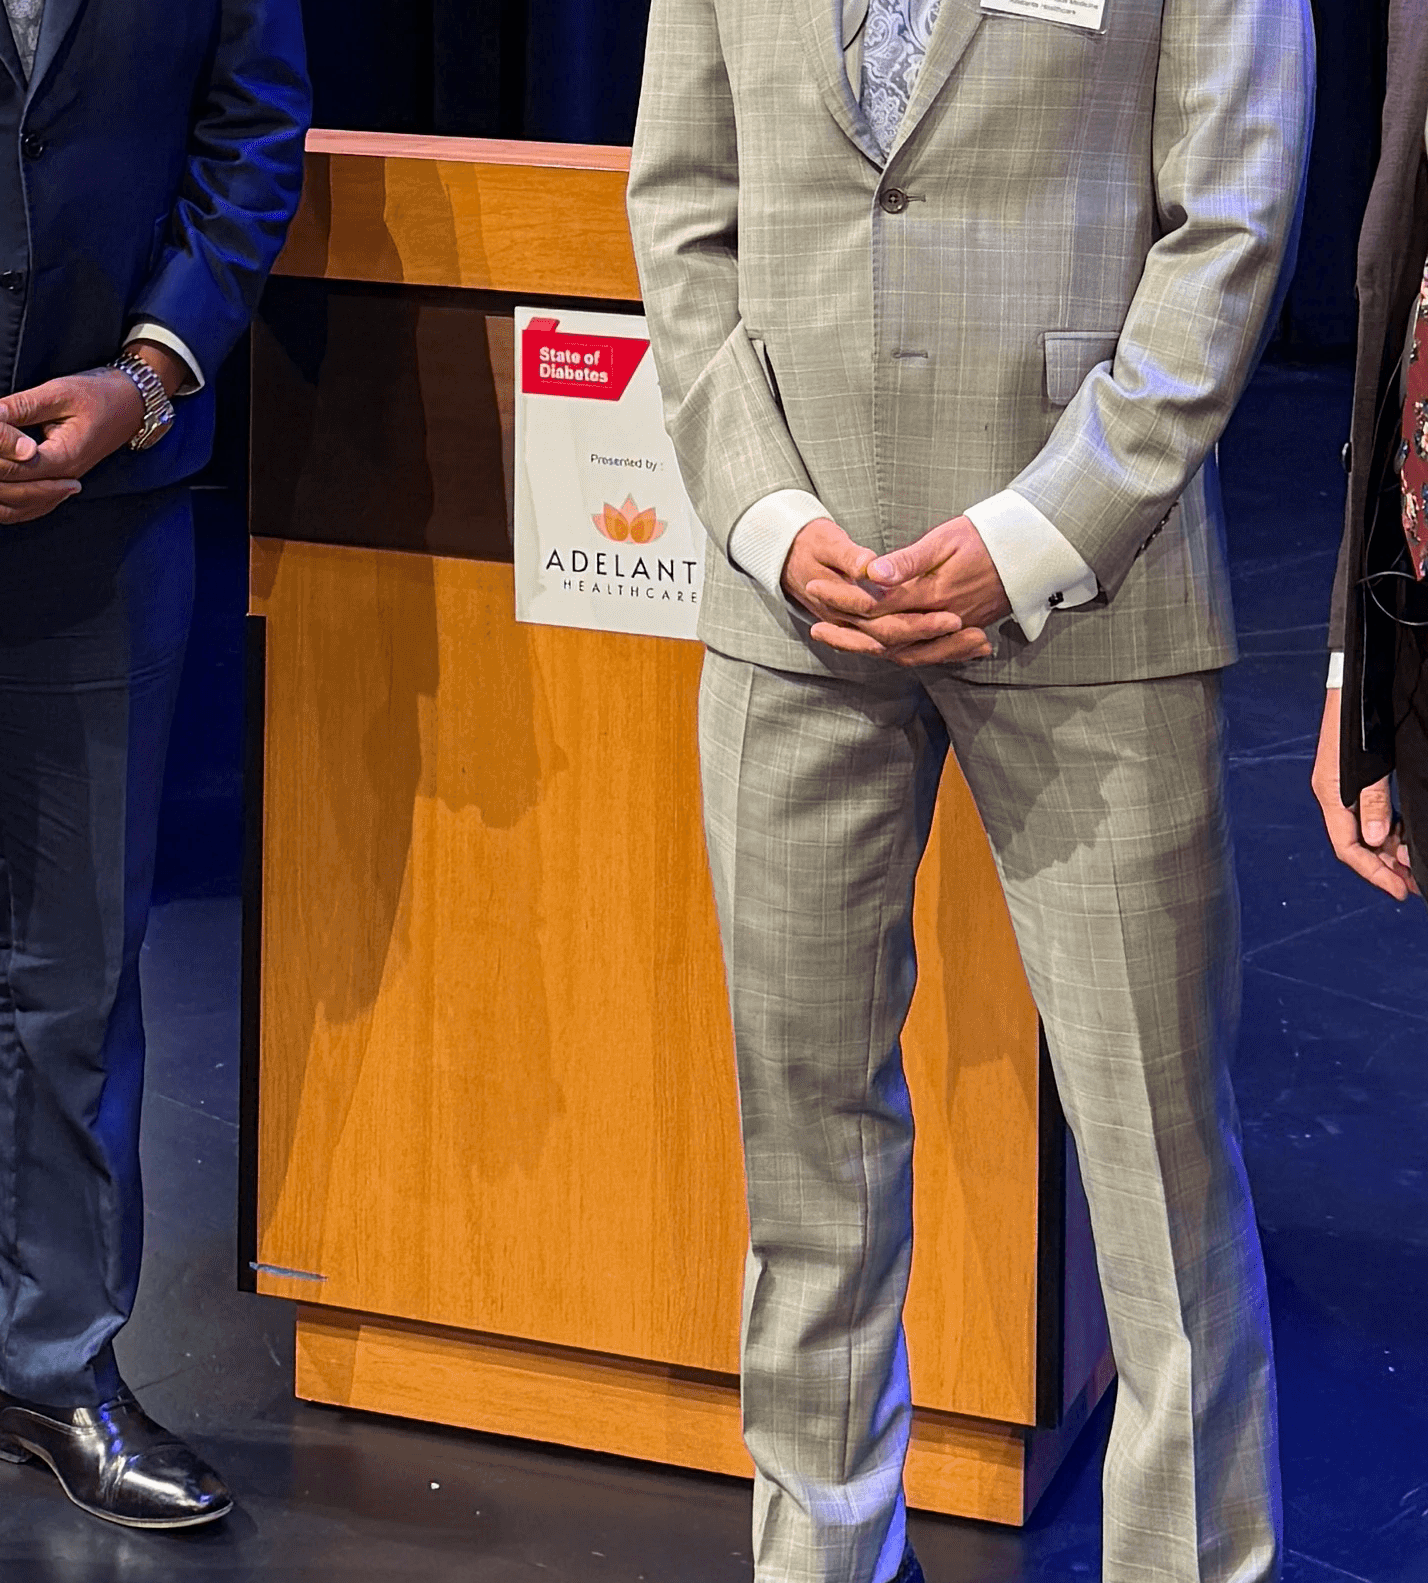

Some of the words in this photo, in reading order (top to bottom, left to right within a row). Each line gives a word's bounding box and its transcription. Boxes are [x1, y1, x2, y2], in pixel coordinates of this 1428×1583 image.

[539, 346, 581, 365] State
[584, 350, 600, 366] of
[539, 363, 608, 383] Diabetes
[590, 454, 642, 468] Presented
[563, 579, 697, 603] HEALTHCARE
